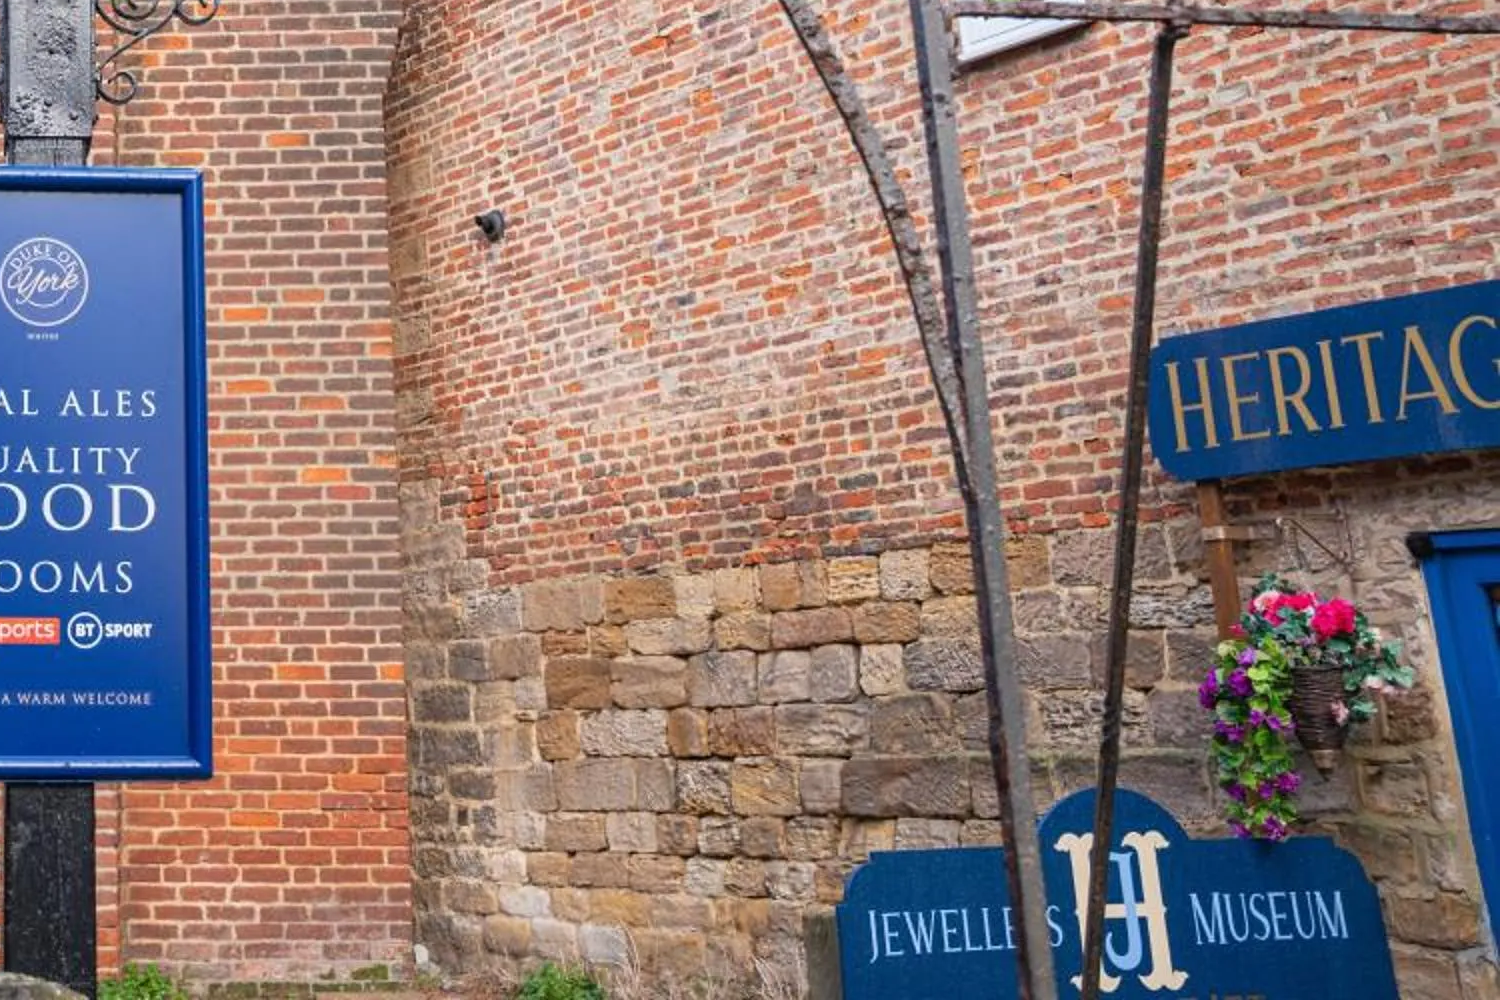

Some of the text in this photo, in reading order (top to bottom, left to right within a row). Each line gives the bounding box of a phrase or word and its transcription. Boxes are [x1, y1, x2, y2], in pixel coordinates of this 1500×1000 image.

[10, 243, 52, 269] DUKE
[7, 263, 79, 305] York
[59, 390, 156, 417] ALES
[75, 623, 152, 638] BT SPORT
[1, 693, 11, 705] A
[17, 692, 65, 705] WARM
[73, 693, 152, 705] WELCOME
[1189, 890, 1349, 945] MUSEUM
[868, 904, 1064, 964] JEWELLES
